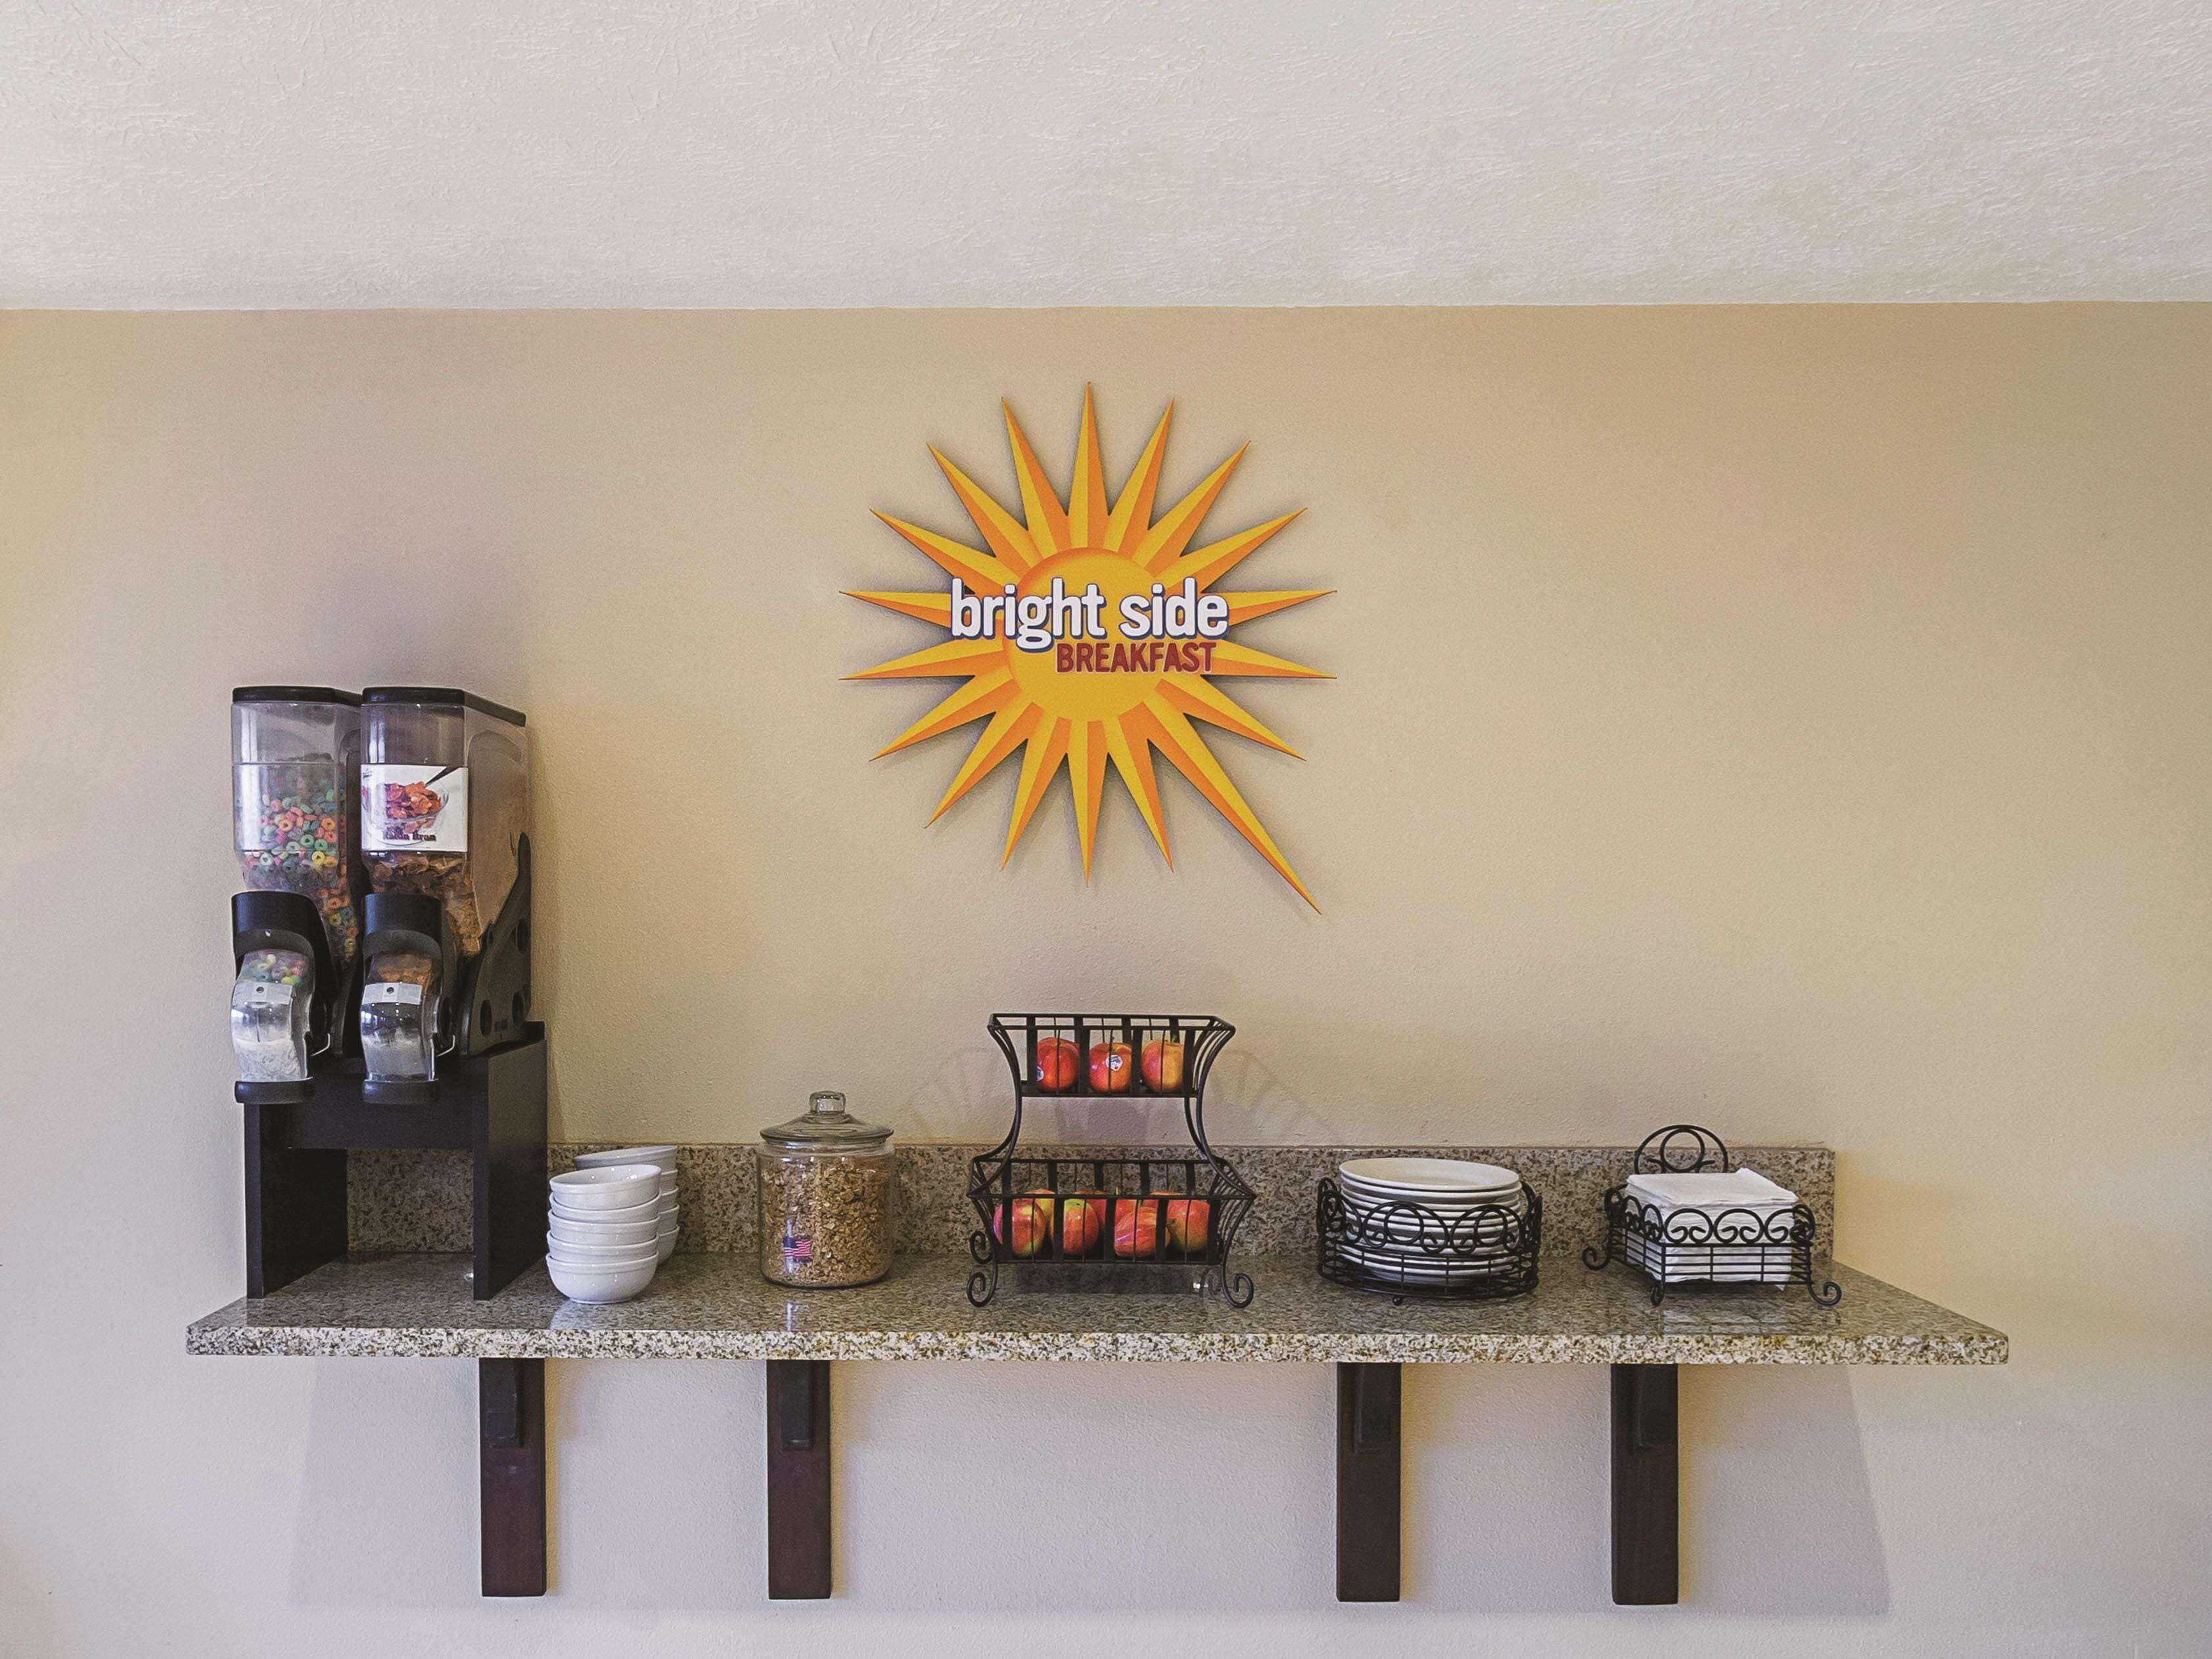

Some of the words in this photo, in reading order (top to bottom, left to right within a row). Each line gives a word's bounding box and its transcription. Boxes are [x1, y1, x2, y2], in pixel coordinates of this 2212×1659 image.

[951, 577, 1106, 653] bright
[1119, 576, 1230, 640] side
[1055, 642, 1217, 674] BREAKFAST
